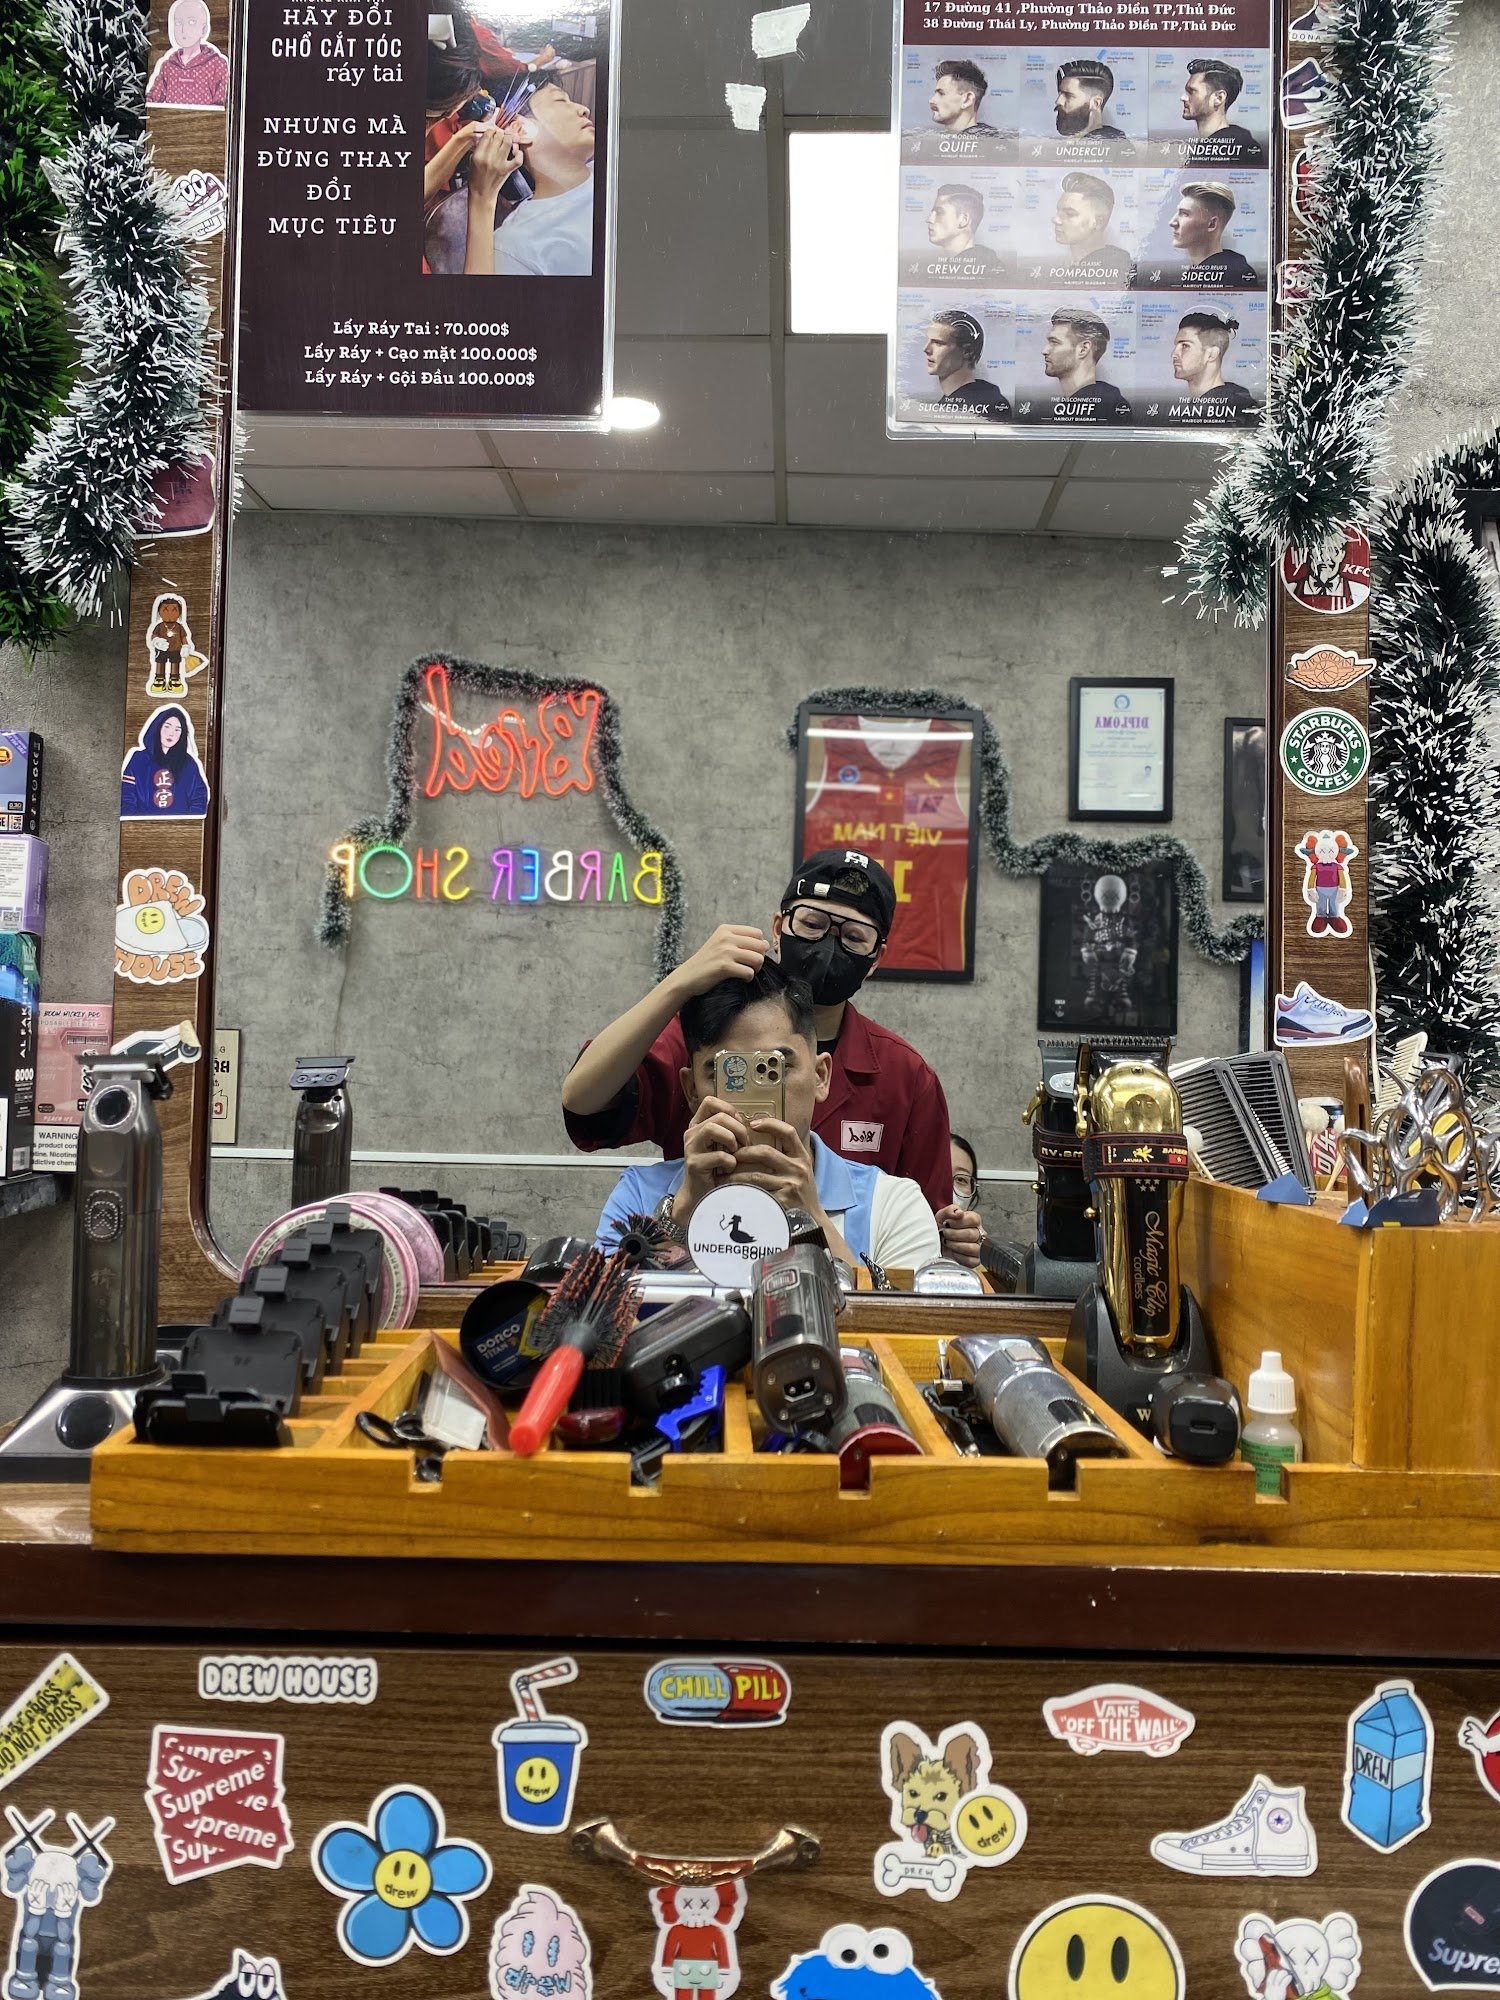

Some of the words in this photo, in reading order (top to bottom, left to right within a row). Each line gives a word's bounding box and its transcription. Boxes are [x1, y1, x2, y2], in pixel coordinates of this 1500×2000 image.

[283, 6, 337, 25] HÃY
[348, 2, 393, 25] ĐỔI
[924, 2, 940, 12] 17
[995, 3, 1012, 13] 41
[1078, 3, 1113, 14] Thảo
[1208, 4, 1236, 15] Đức
[923, 18, 939, 28] 38
[987, 19, 1016, 29] Thái
[1019, 20, 1038, 31] Ly,
[1093, 19, 1125, 30] Thảo
[1211, 21, 1236, 31] Đức
[271, 31, 312, 57] CHỔ
[321, 31, 356, 57] CẮT
[365, 33, 402, 57] TÓC
[1291, 33, 1322, 41] DONA
[327, 62, 365, 87] ráy
[373, 63, 403, 82] tai
[263, 116, 356, 134] NHƯNG
[367, 114, 407, 134] MÀ
[257, 147, 329, 167] ĐỪNG
[341, 151, 411, 167] THAY
[939, 141, 979, 153] QUIFF
[1056, 146, 1110, 156] UNDERCUT
[1178, 145, 1242, 156] UNDERCUT
[307, 176, 352, 200] ĐỔI
[268, 217, 325, 238] MỤC
[336, 214, 396, 235] TIÊU
[927, 264, 960, 275] CREW
[964, 264, 986, 275] CUT
[1050, 268, 1118, 278] POMPADOUR
[1181, 271, 1224, 281] SIDECUT
[333, 318, 364, 338] Lấy
[368, 320, 400, 338] Ráy
[404, 322, 431, 335] Tai
[443, 322, 510, 337] 70.000$
[304, 342, 335, 362] Lấy
[339, 344, 371, 362] Ráy
[388, 347, 419, 362] Cạo
[423, 346, 457, 362] mặt
[460, 347, 538, 361] 100.000$
[305, 367, 336, 387] Lấy
[340, 370, 372, 387] Ráy
[389, 371, 417, 387] Gội
[421, 368, 454, 385] Đầu
[458, 371, 535, 386] 100.000$
[1054, 403, 1095, 415] QUIFF
[1168, 406, 1202, 417] MAN
[1207, 406, 1236, 418] BUN
[1342, 563, 1371, 578] KFC
[1300, 657, 1317, 670] AIR
[1317, 651, 1352, 668] JORDAN
[1288, 715, 1362, 750] STARBUCKS
[1296, 768, 1353, 789] COFFEE
[128, 872, 202, 917] DREW
[15, 1068, 34, 1082] 8000
[38, 1132, 78, 1140] WARNING
[38, 1142, 64, 1151] product
[693, 1242, 782, 1256] UNDERGROUND
[1139, 1211, 1165, 1277] Magic
[1133, 1256, 1146, 1300] cordless
[1139, 1281, 1168, 1318] Clip
[476, 1323, 521, 1354] DORCO
[204, 1662, 279, 1696] DREW
[283, 1664, 372, 1698] HOUSE
[659, 1675, 727, 1700] CHILL
[736, 1676, 782, 1701] PILL
[1093, 1699, 1141, 1719] VANS
[12, 1725, 42, 1756] NOT
[38, 1694, 83, 1735] CROSS
[1098, 1718, 1132, 1742] THE
[1355, 1747, 1391, 1786] DREW
[160, 1763, 266, 1819] Supreme
[522, 1785, 550, 1797] drew
[183, 1815, 277, 1849] preme
[977, 1822, 1008, 1848] drew
[904, 1867, 933, 1875] DREW
[385, 1884, 418, 1899] drew
[1428, 1937, 1500, 1975] Supre
[505, 1965, 571, 1997] drew
